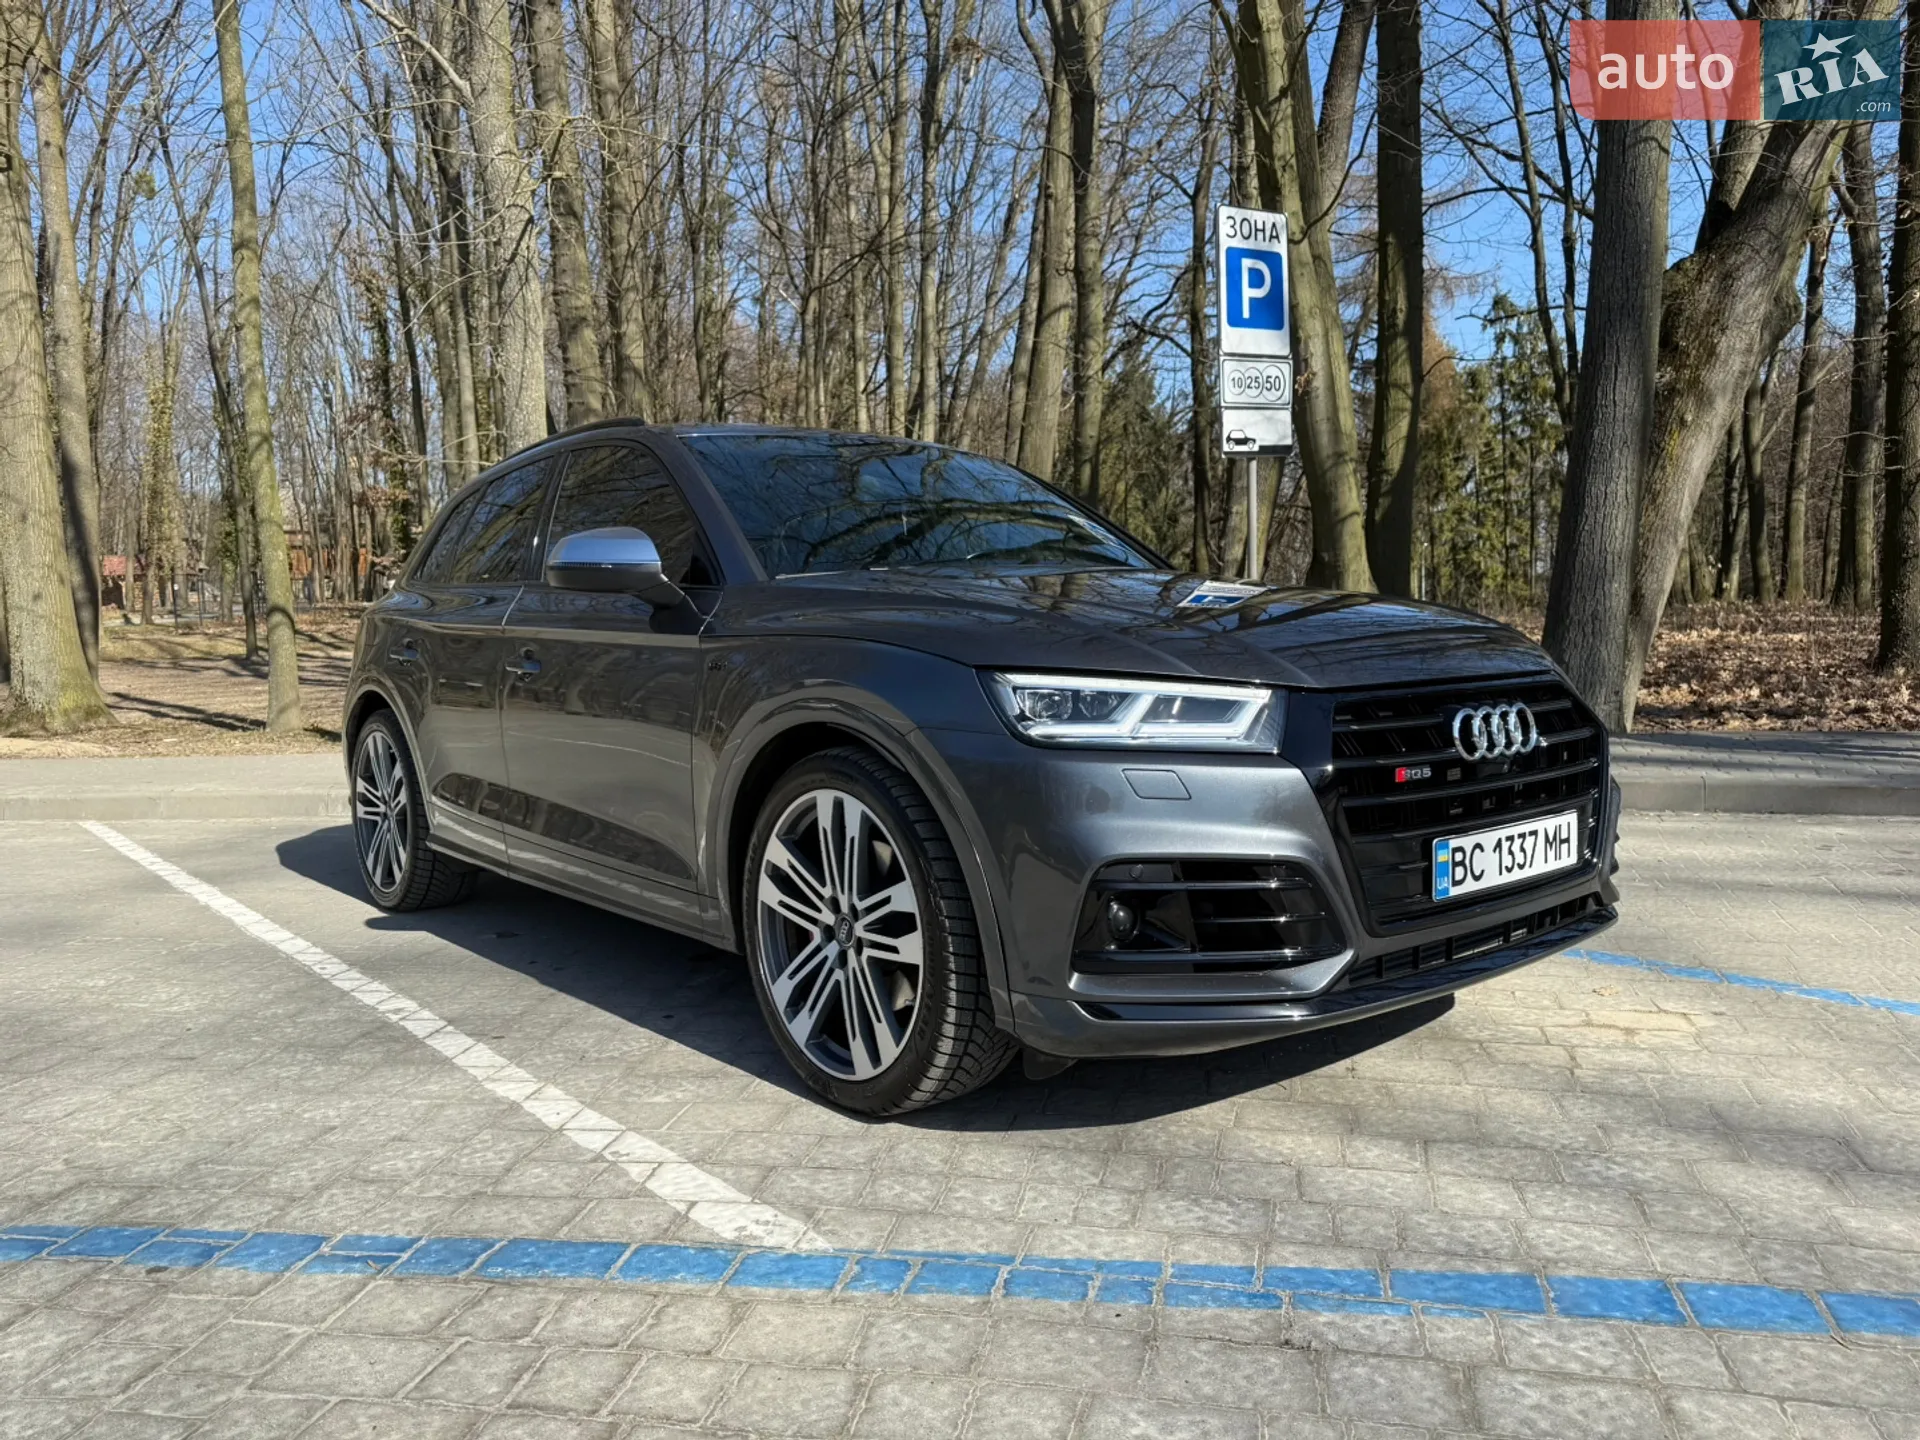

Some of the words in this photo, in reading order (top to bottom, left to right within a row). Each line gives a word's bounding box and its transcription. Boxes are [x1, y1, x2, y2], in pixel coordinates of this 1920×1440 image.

[1225, 215, 1281, 244] ЗОНА
[1241, 257, 1272, 319] P
[1231, 377, 1243, 389] 10
[1247, 376, 1260, 390] 25
[1265, 375, 1281, 392] 50
[1451, 842, 1485, 888] BC
[1493, 829, 1538, 876] 1337
[1544, 821, 1571, 864] MH
